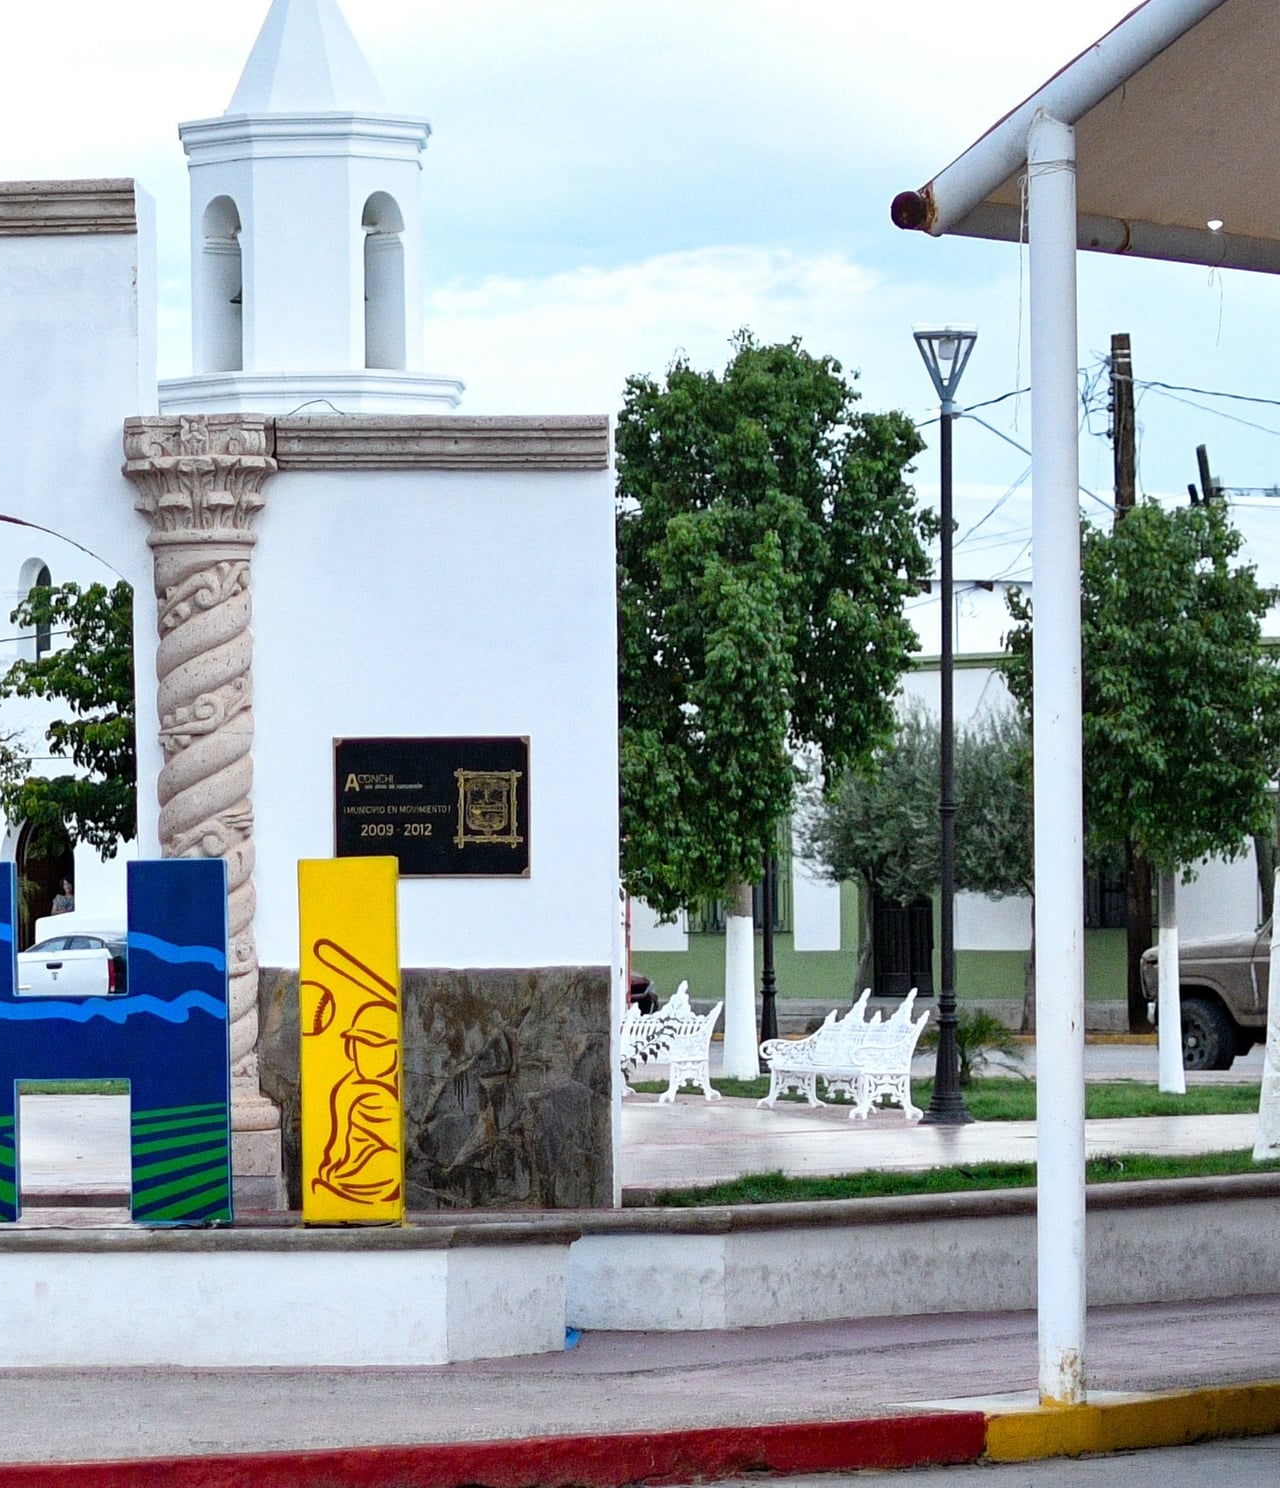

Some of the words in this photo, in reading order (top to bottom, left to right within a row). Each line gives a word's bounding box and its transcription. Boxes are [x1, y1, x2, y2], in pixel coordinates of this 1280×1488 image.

[344, 773, 394, 792] ACONCHI
[387, 805, 398, 814] EN
[360, 823, 394, 836] 2009
[403, 823, 432, 836] 2012
